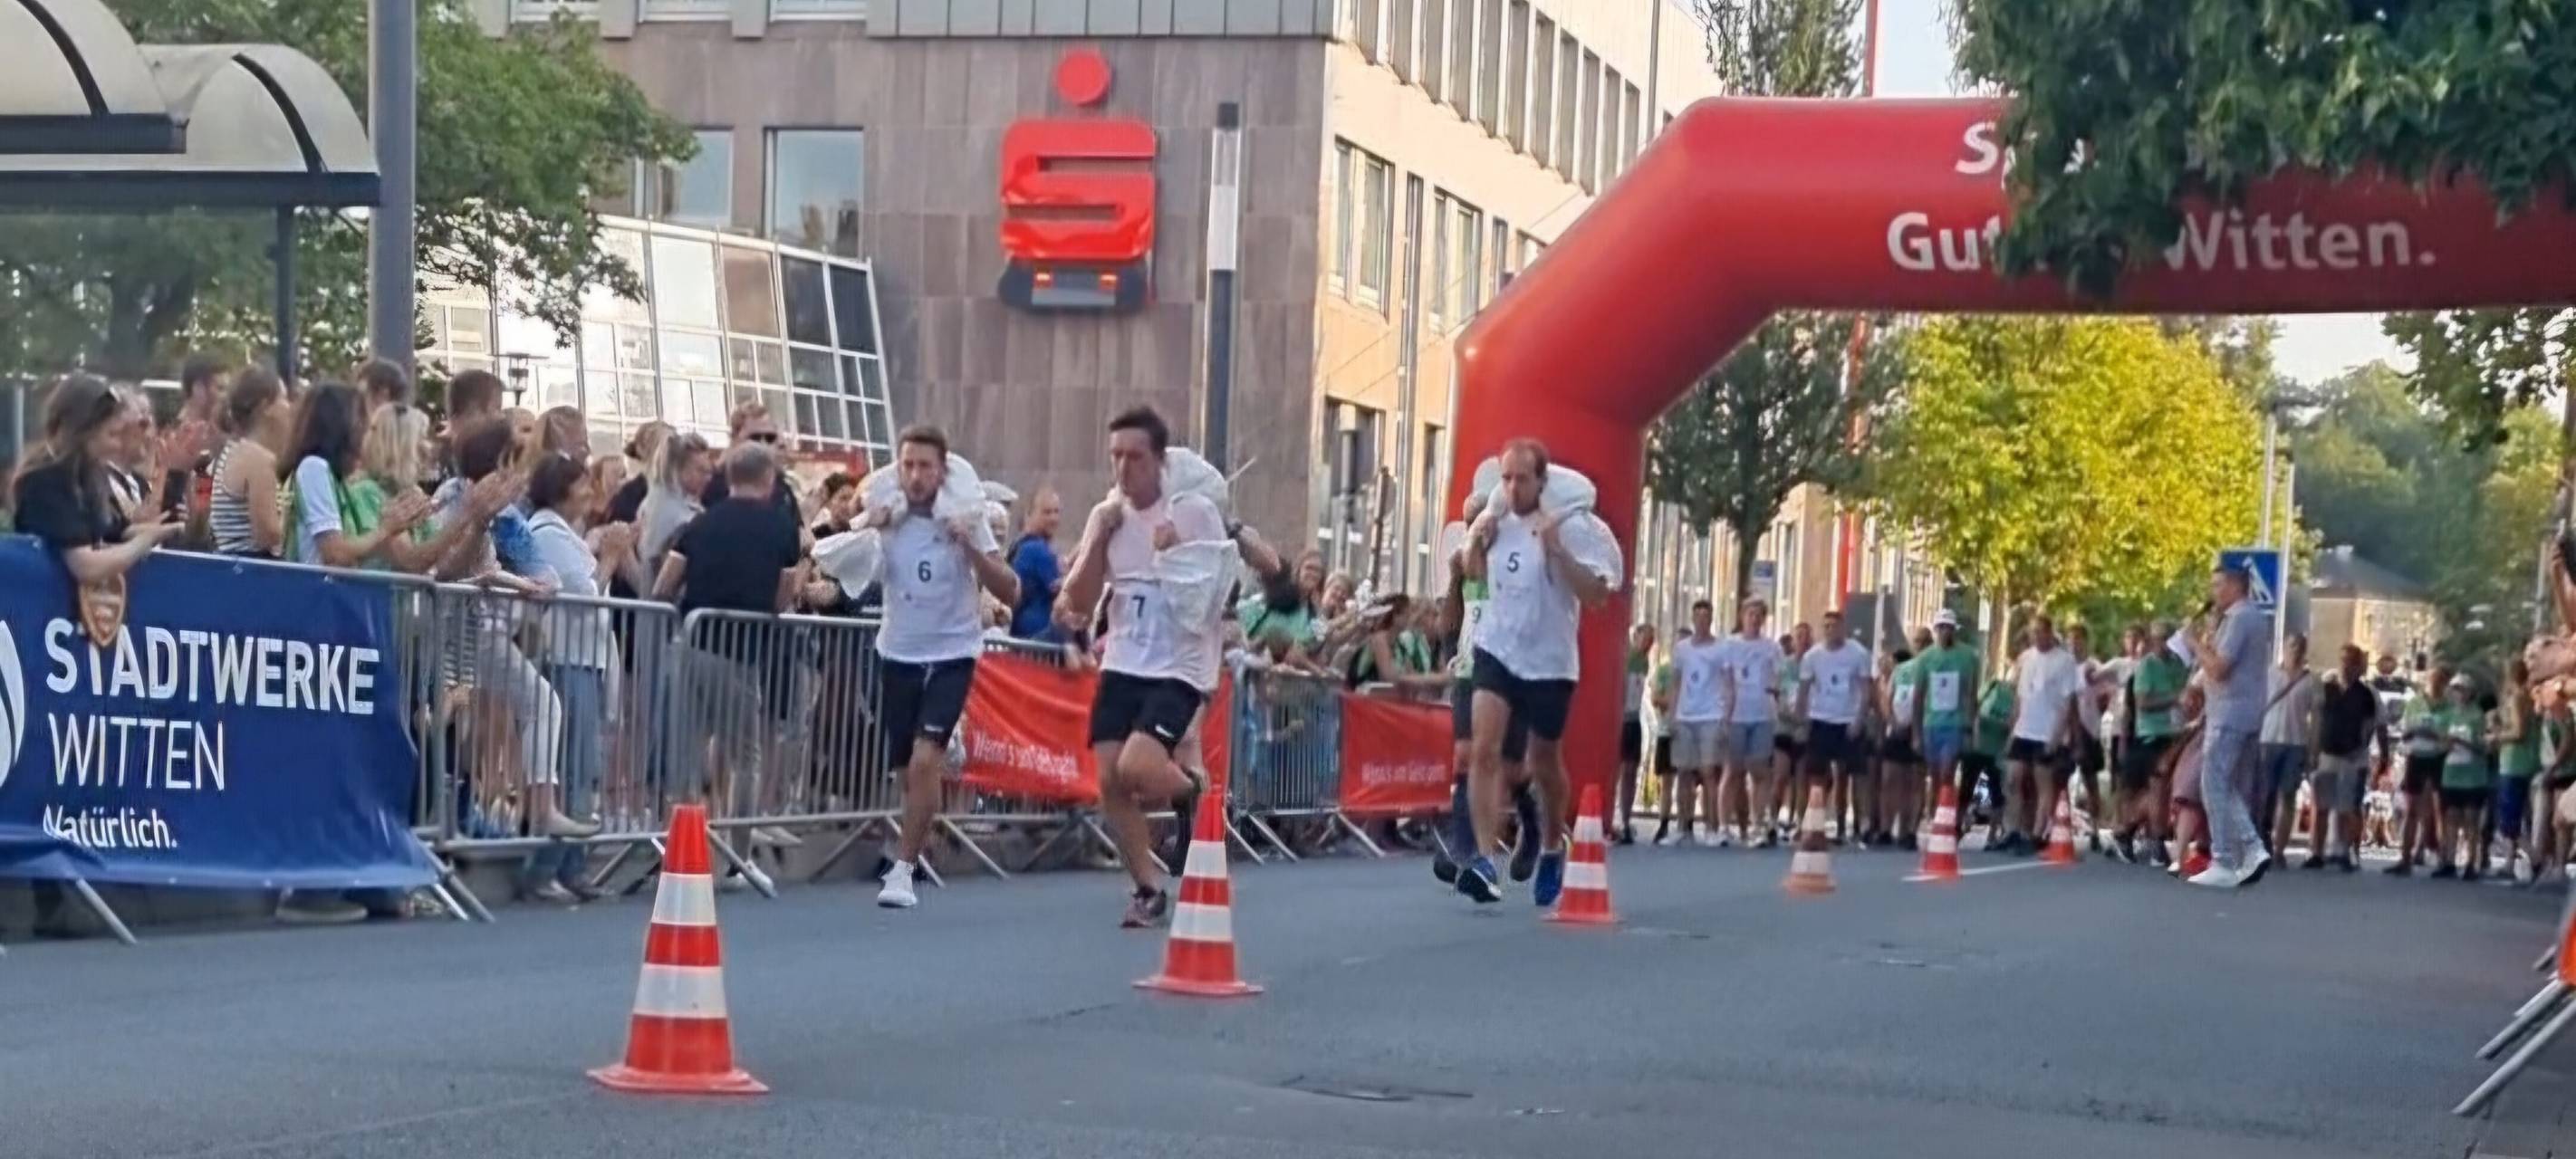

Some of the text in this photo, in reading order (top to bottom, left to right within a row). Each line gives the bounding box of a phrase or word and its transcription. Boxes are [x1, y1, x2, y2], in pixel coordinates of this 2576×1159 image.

[2162, 206, 2437, 271] Witten.
[918, 560, 932, 583] 6
[1506, 551, 1521, 573] 5
[1131, 594, 1146, 619] 7
[48, 711, 226, 791] WITTEN
[43, 803, 178, 849] Natürlich.
